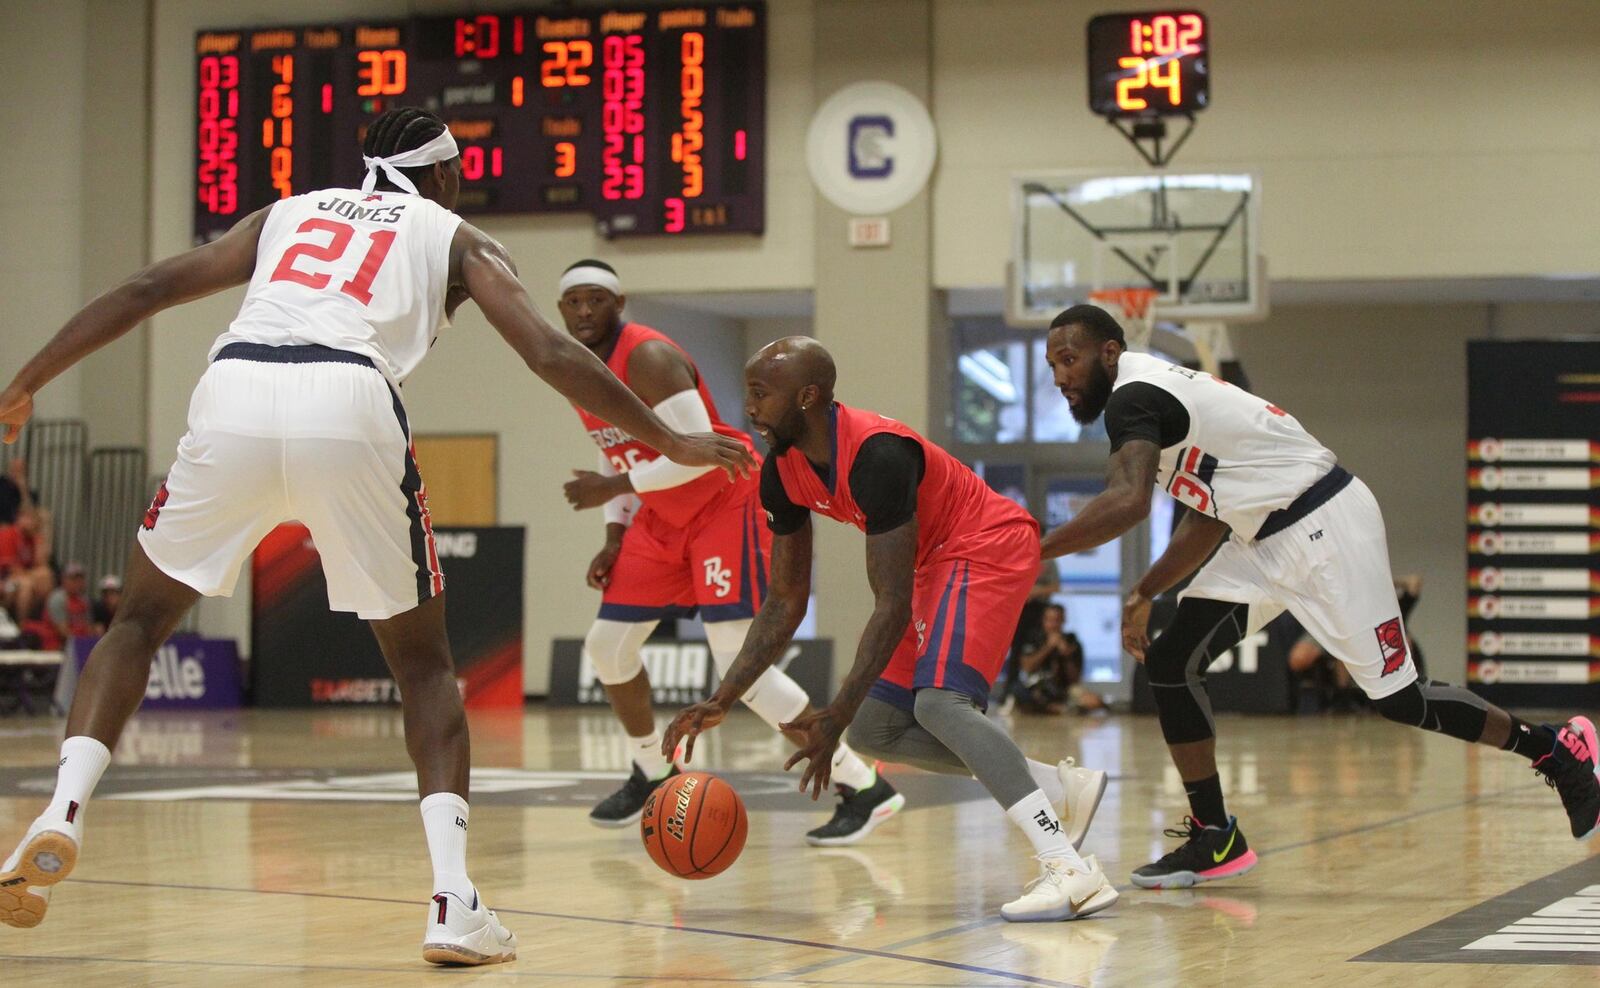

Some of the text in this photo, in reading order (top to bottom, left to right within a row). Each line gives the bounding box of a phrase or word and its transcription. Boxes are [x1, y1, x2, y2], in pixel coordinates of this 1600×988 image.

[681, 32, 703, 66] 0
[1130, 14, 1202, 55] 1:02
[541, 41, 592, 87] 22
[603, 35, 644, 68] 05
[200, 56, 238, 89] 03
[272, 54, 293, 84] 4
[357, 50, 407, 96] 30
[603, 68, 644, 100] 03
[681, 66, 703, 99] 0
[1117, 56, 1181, 110] 24
[199, 88, 238, 119] 01
[272, 84, 293, 118] 6
[322, 83, 333, 113] 1
[512, 76, 524, 107] 1
[603, 100, 644, 133] 06
[555, 143, 575, 177] 3
[735, 130, 746, 160] 1
[603, 164, 644, 199] 23
[317, 197, 406, 223] JONES
[664, 198, 685, 233] 3
[269, 217, 397, 307] 21
[144, 644, 207, 700] elle
